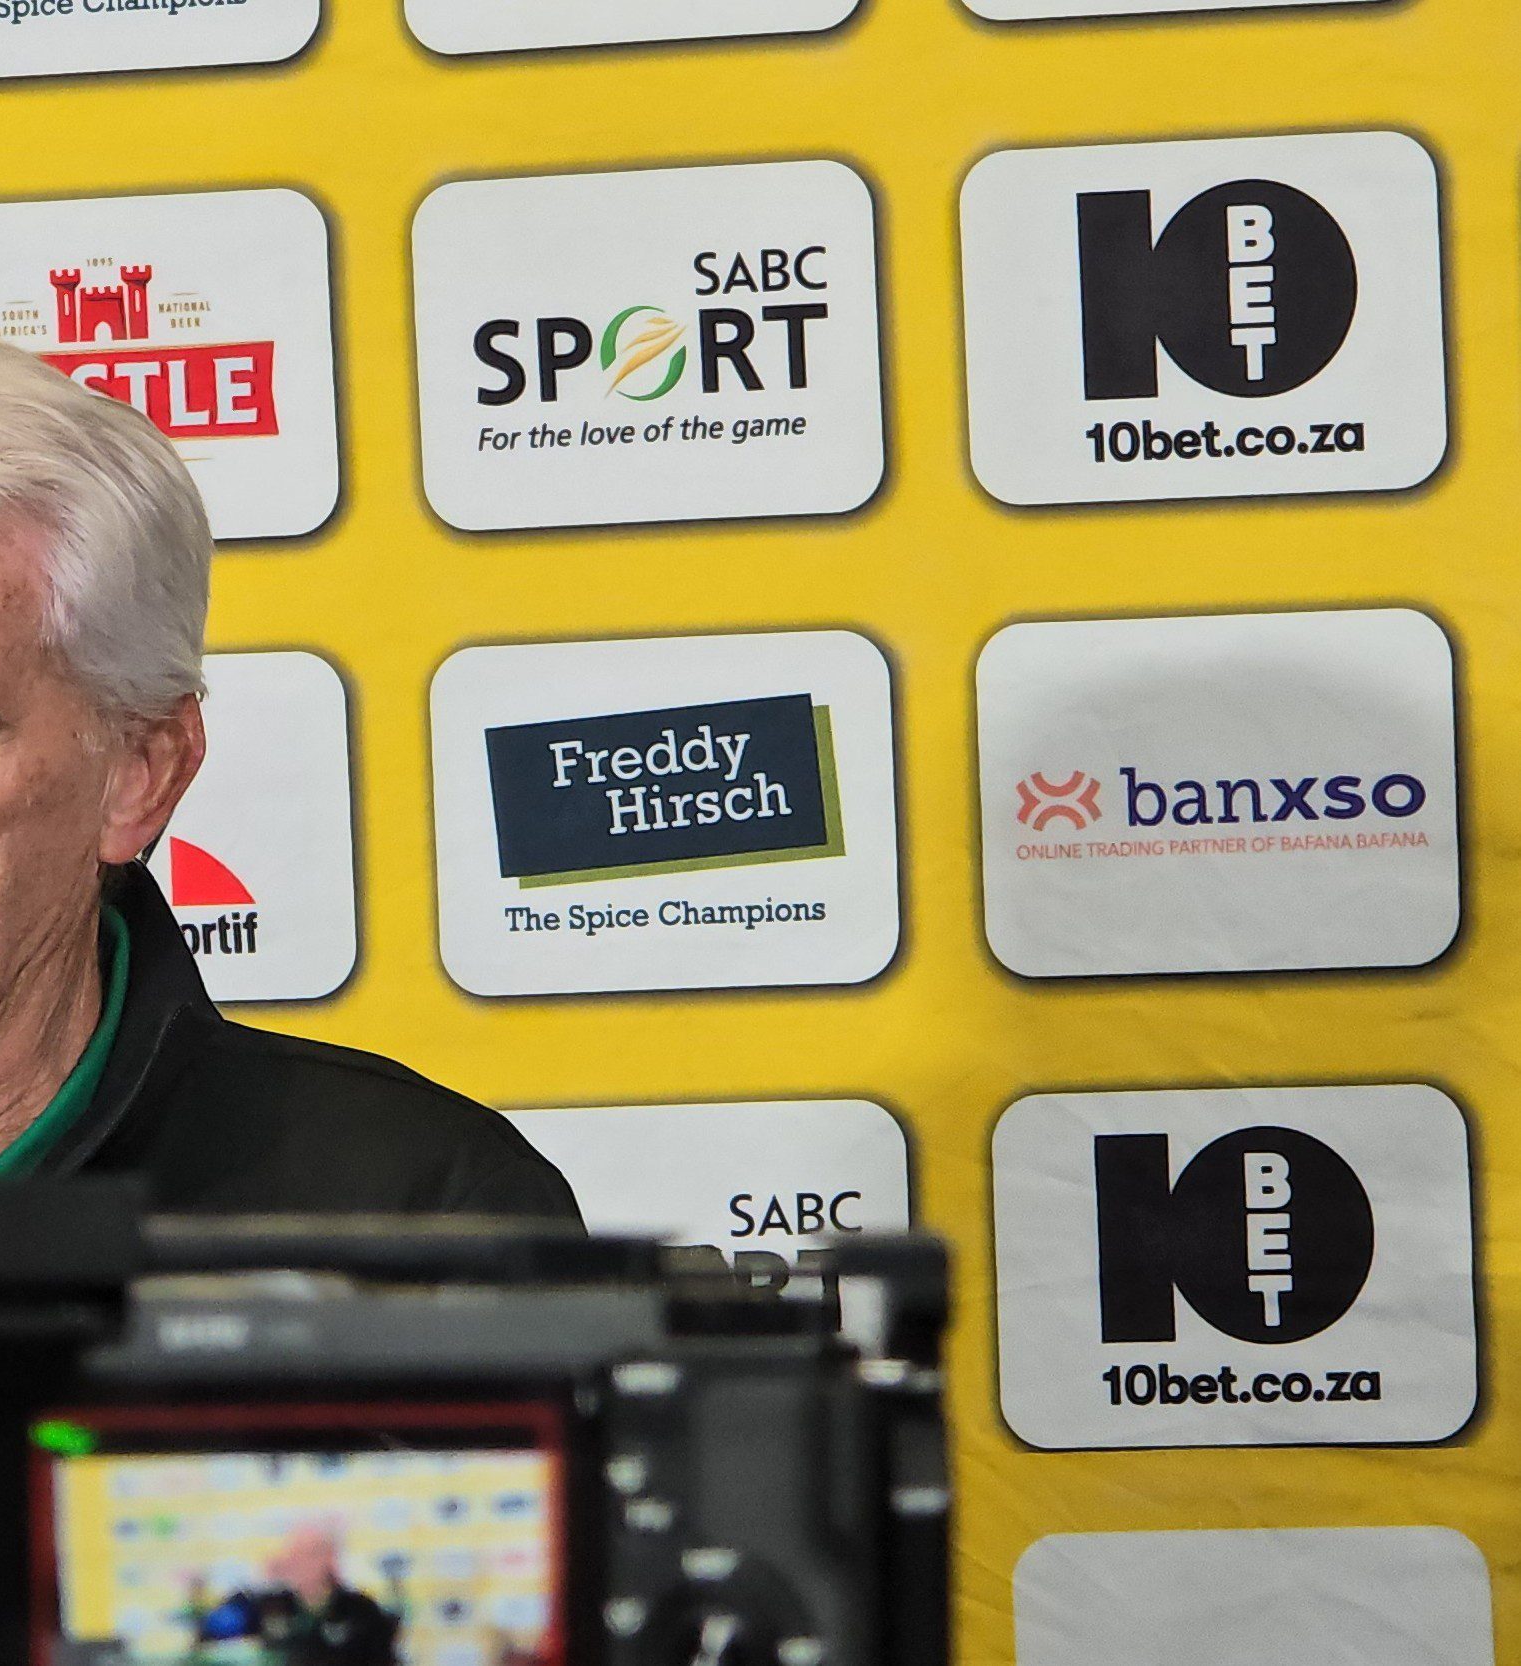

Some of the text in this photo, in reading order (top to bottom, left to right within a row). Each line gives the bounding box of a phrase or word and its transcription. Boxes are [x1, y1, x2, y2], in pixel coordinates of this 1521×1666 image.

[693, 246, 827, 296] SABC
[1226, 204, 1277, 381] BET
[2, 310, 39, 321] SOUTH
[158, 300, 212, 313] NATIONAL
[170, 317, 201, 329] BEER
[473, 303, 828, 406] SPORT
[479, 415, 807, 451] For the love of the game
[1086, 419, 1365, 463] 10bet.co.za
[549, 725, 751, 789] Freddy
[606, 773, 793, 835] Hirsch
[1119, 766, 1427, 828] banxso
[1016, 831, 1429, 860] ONLINE TRADING PARTNER OF BAFANA BAFANA
[505, 896, 827, 936] The Spice Champions
[729, 1190, 863, 1238] SABC
[1243, 1152, 1294, 1327] BET
[1102, 1363, 1382, 1406] 10bet.co.za
